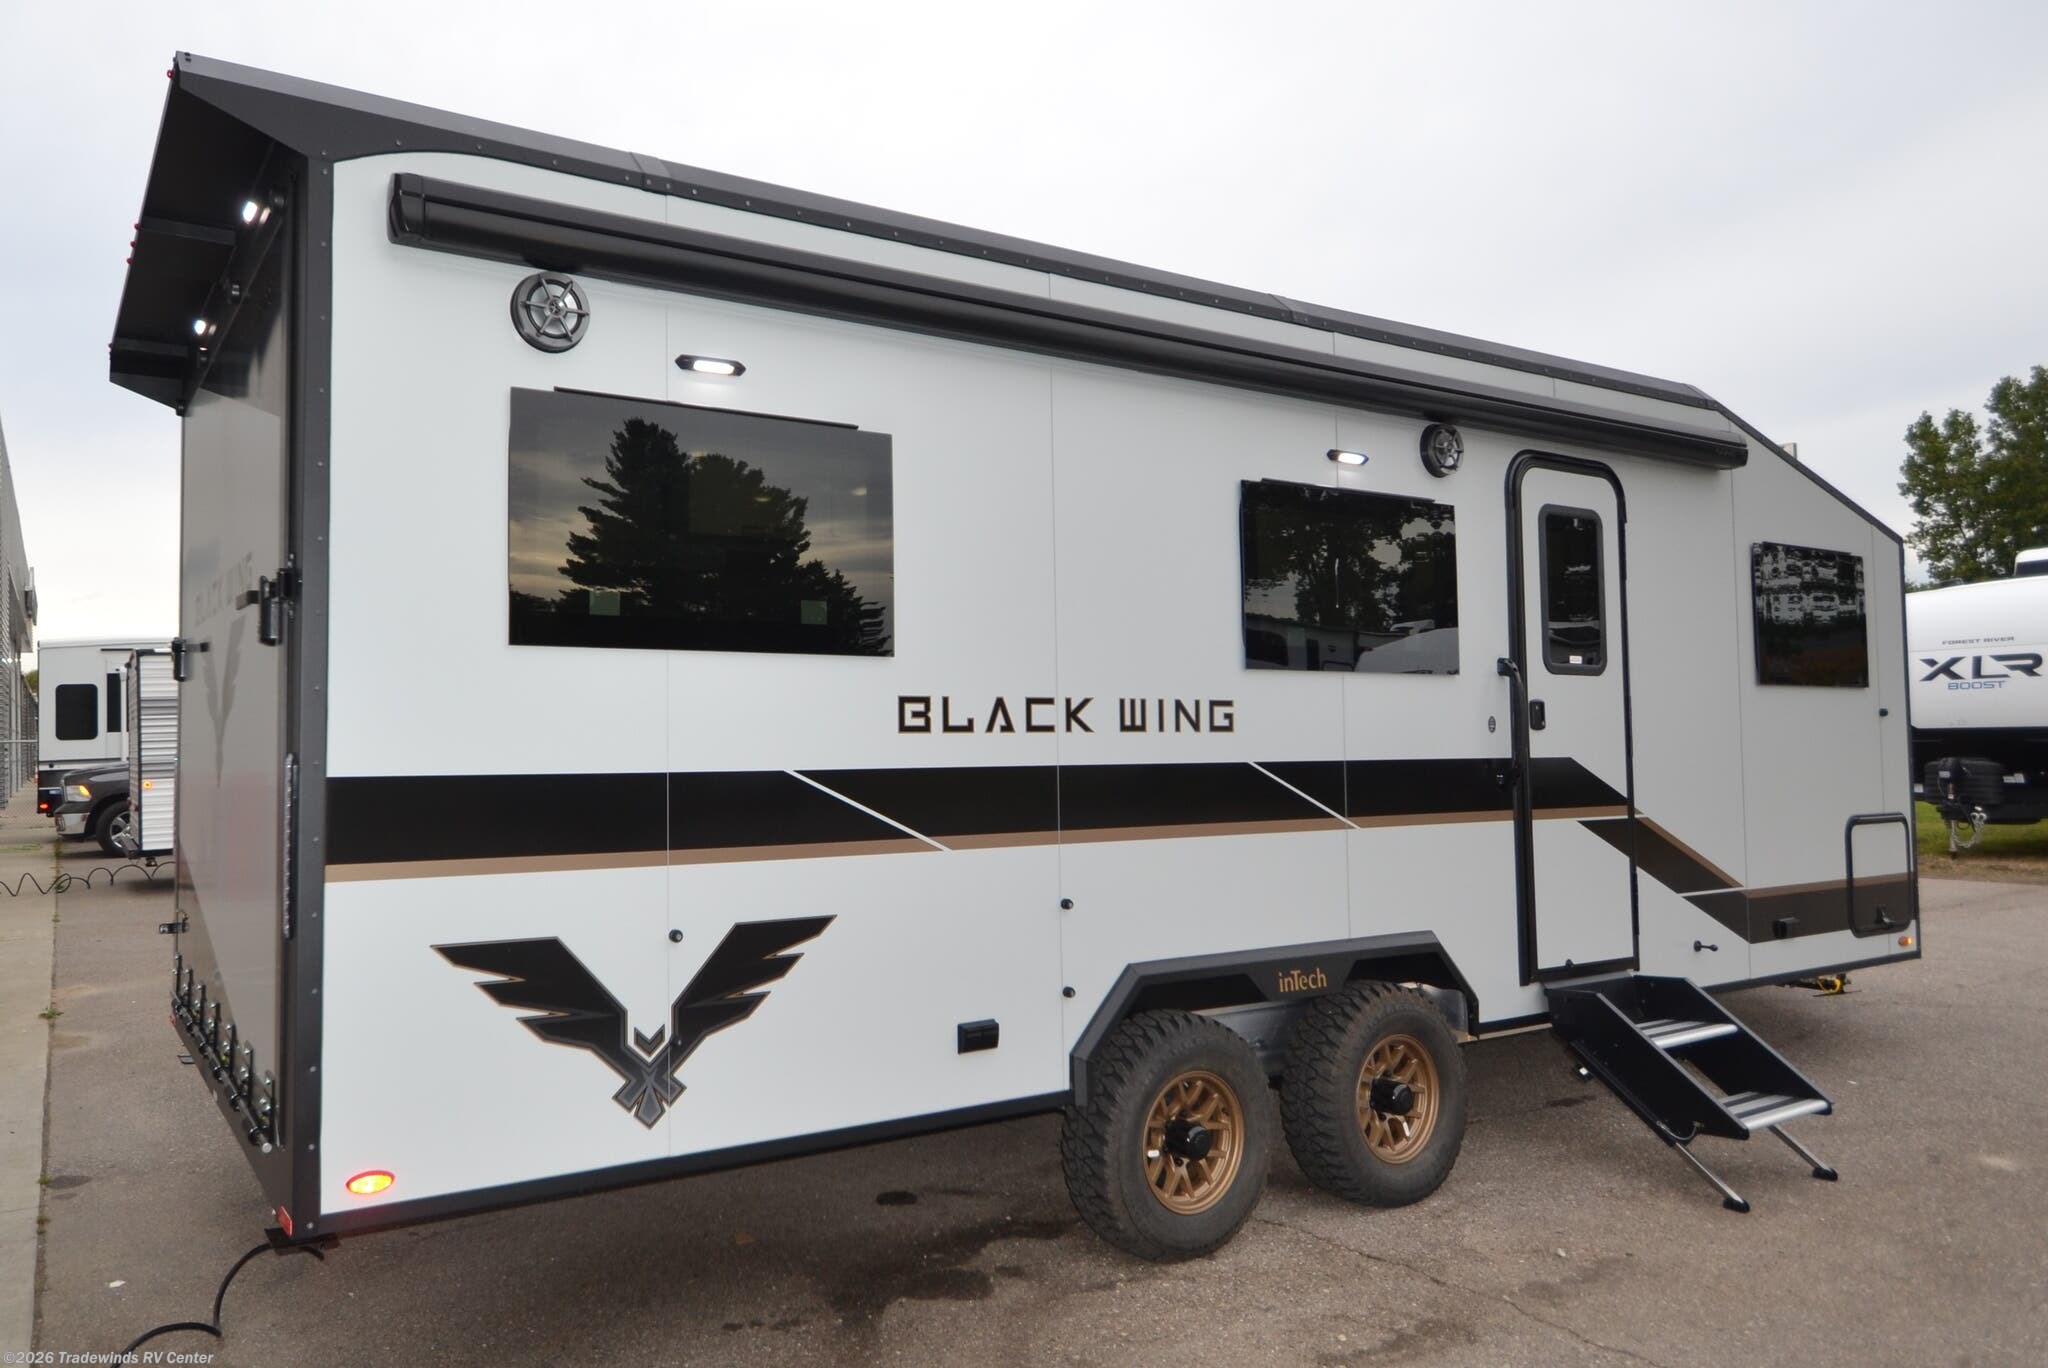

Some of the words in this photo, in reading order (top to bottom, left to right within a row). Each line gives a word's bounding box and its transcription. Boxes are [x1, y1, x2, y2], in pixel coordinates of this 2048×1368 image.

[1919, 652, 2043, 681] XLR
[1947, 680, 2006, 690] BOOST
[898, 695, 1095, 734] BLACK
[1119, 698, 1234, 733] WING
[1278, 967, 1327, 993] inTech
